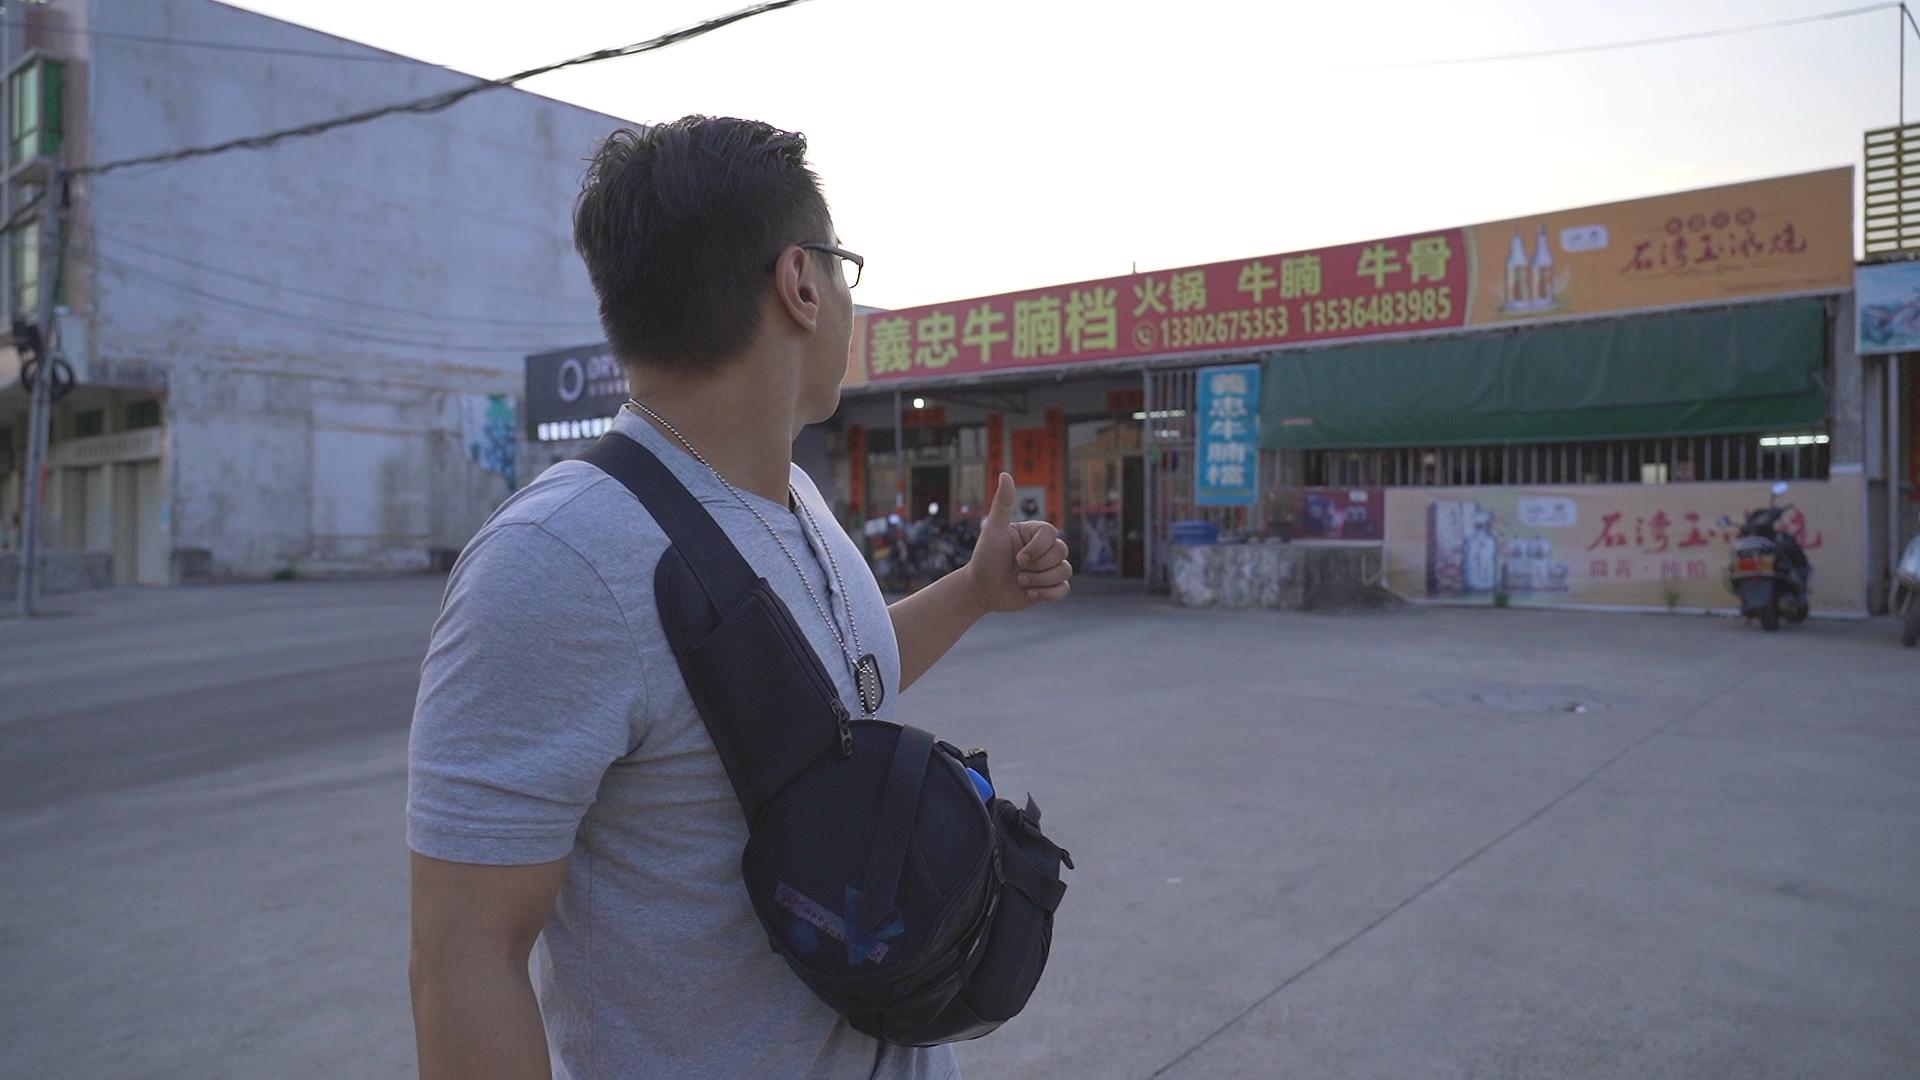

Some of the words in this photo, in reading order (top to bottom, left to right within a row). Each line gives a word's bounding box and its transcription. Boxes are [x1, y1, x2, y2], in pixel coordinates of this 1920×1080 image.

[1133, 271, 1206, 317] 火锅
[1237, 255, 1322, 303] 牛腩
[1356, 237, 1451, 288] 牛骨
[1160, 304, 1289, 348] 13302675353
[1301, 286, 1451, 334] 13536483985
[871, 287, 1118, 375] 義忠牛腩档
